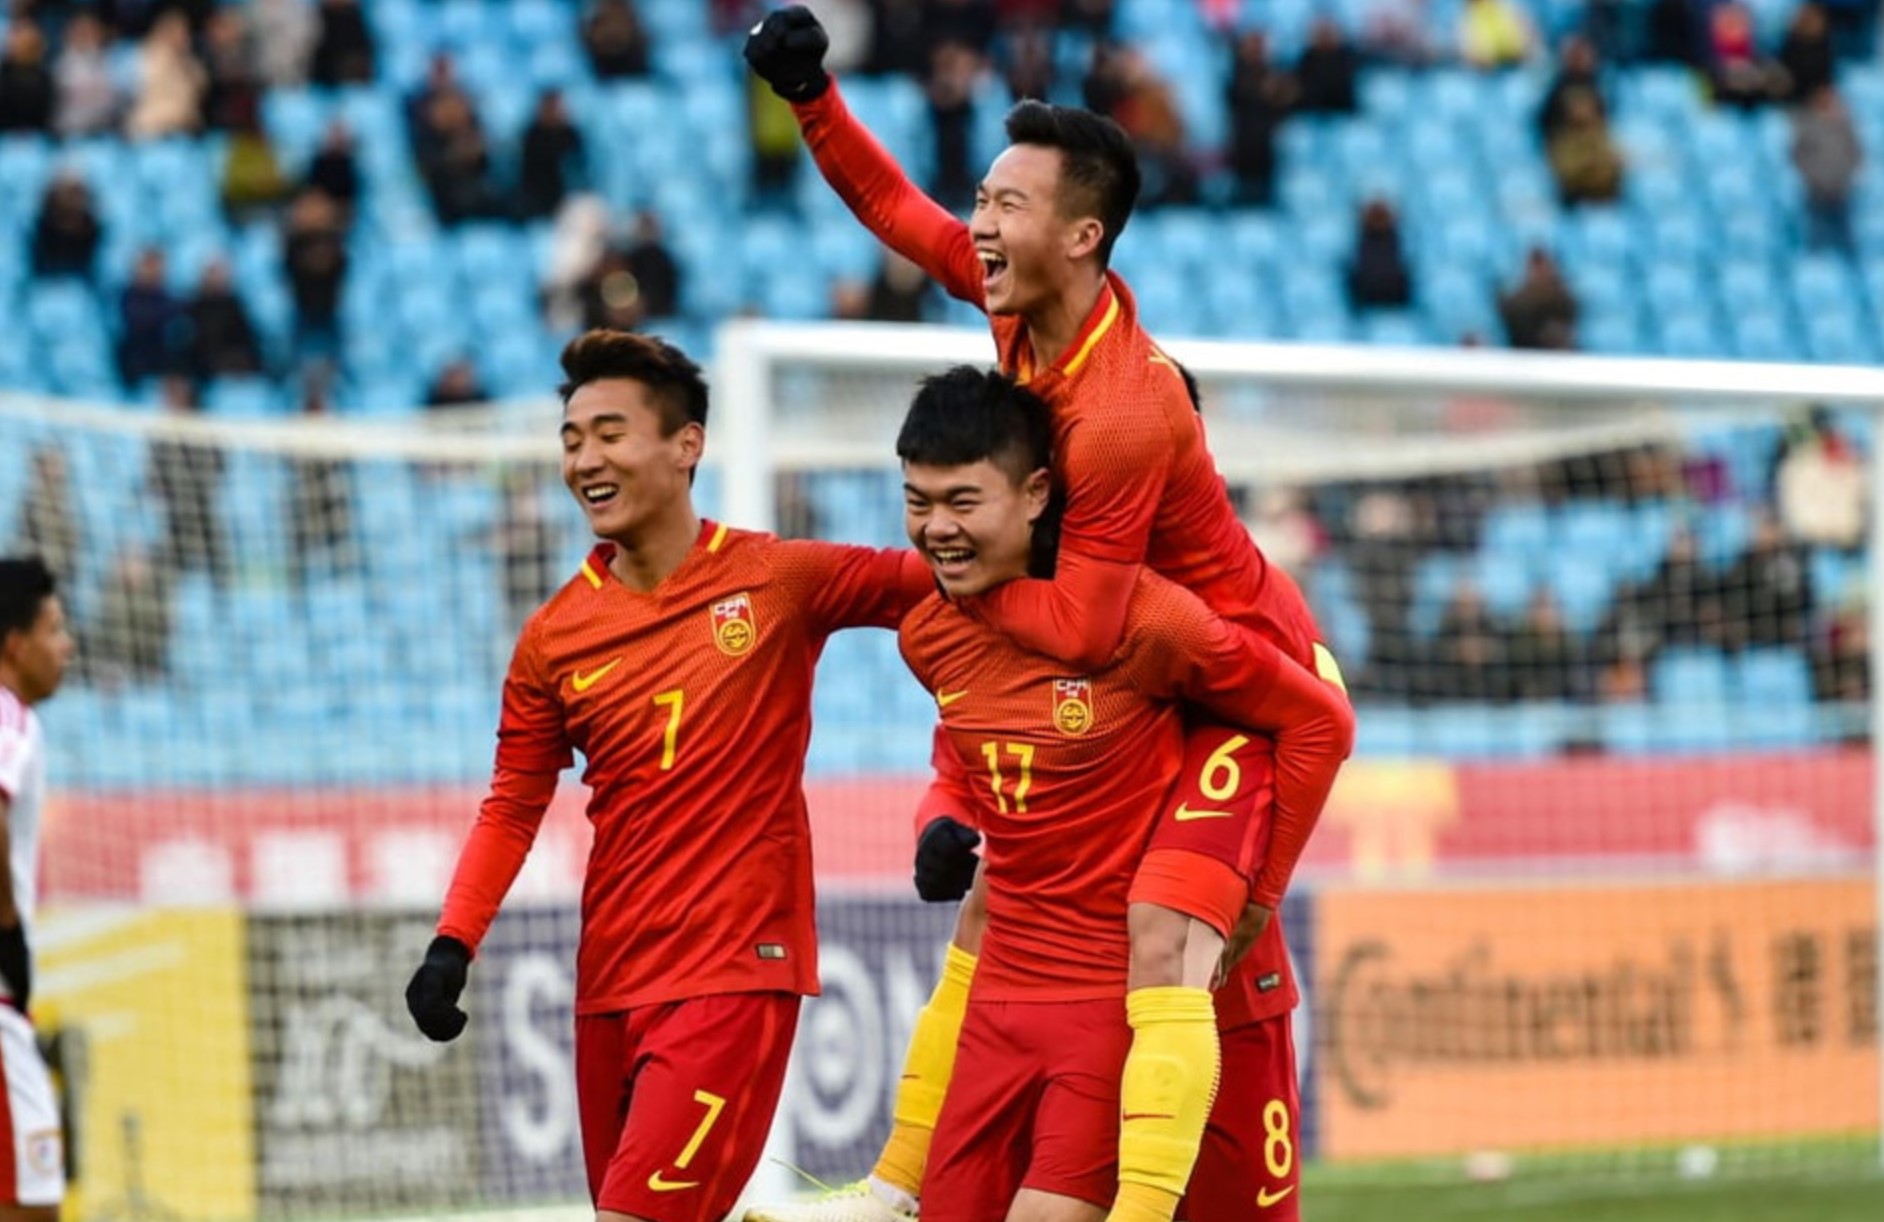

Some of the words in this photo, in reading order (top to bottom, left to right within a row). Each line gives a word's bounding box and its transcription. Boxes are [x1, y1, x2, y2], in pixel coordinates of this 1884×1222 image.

[653, 689, 684, 770] 7
[1199, 735, 1249, 801] 6
[981, 741, 1035, 814] 17
[673, 1089, 726, 1169] 7
[1263, 1099, 1293, 1178] 8
